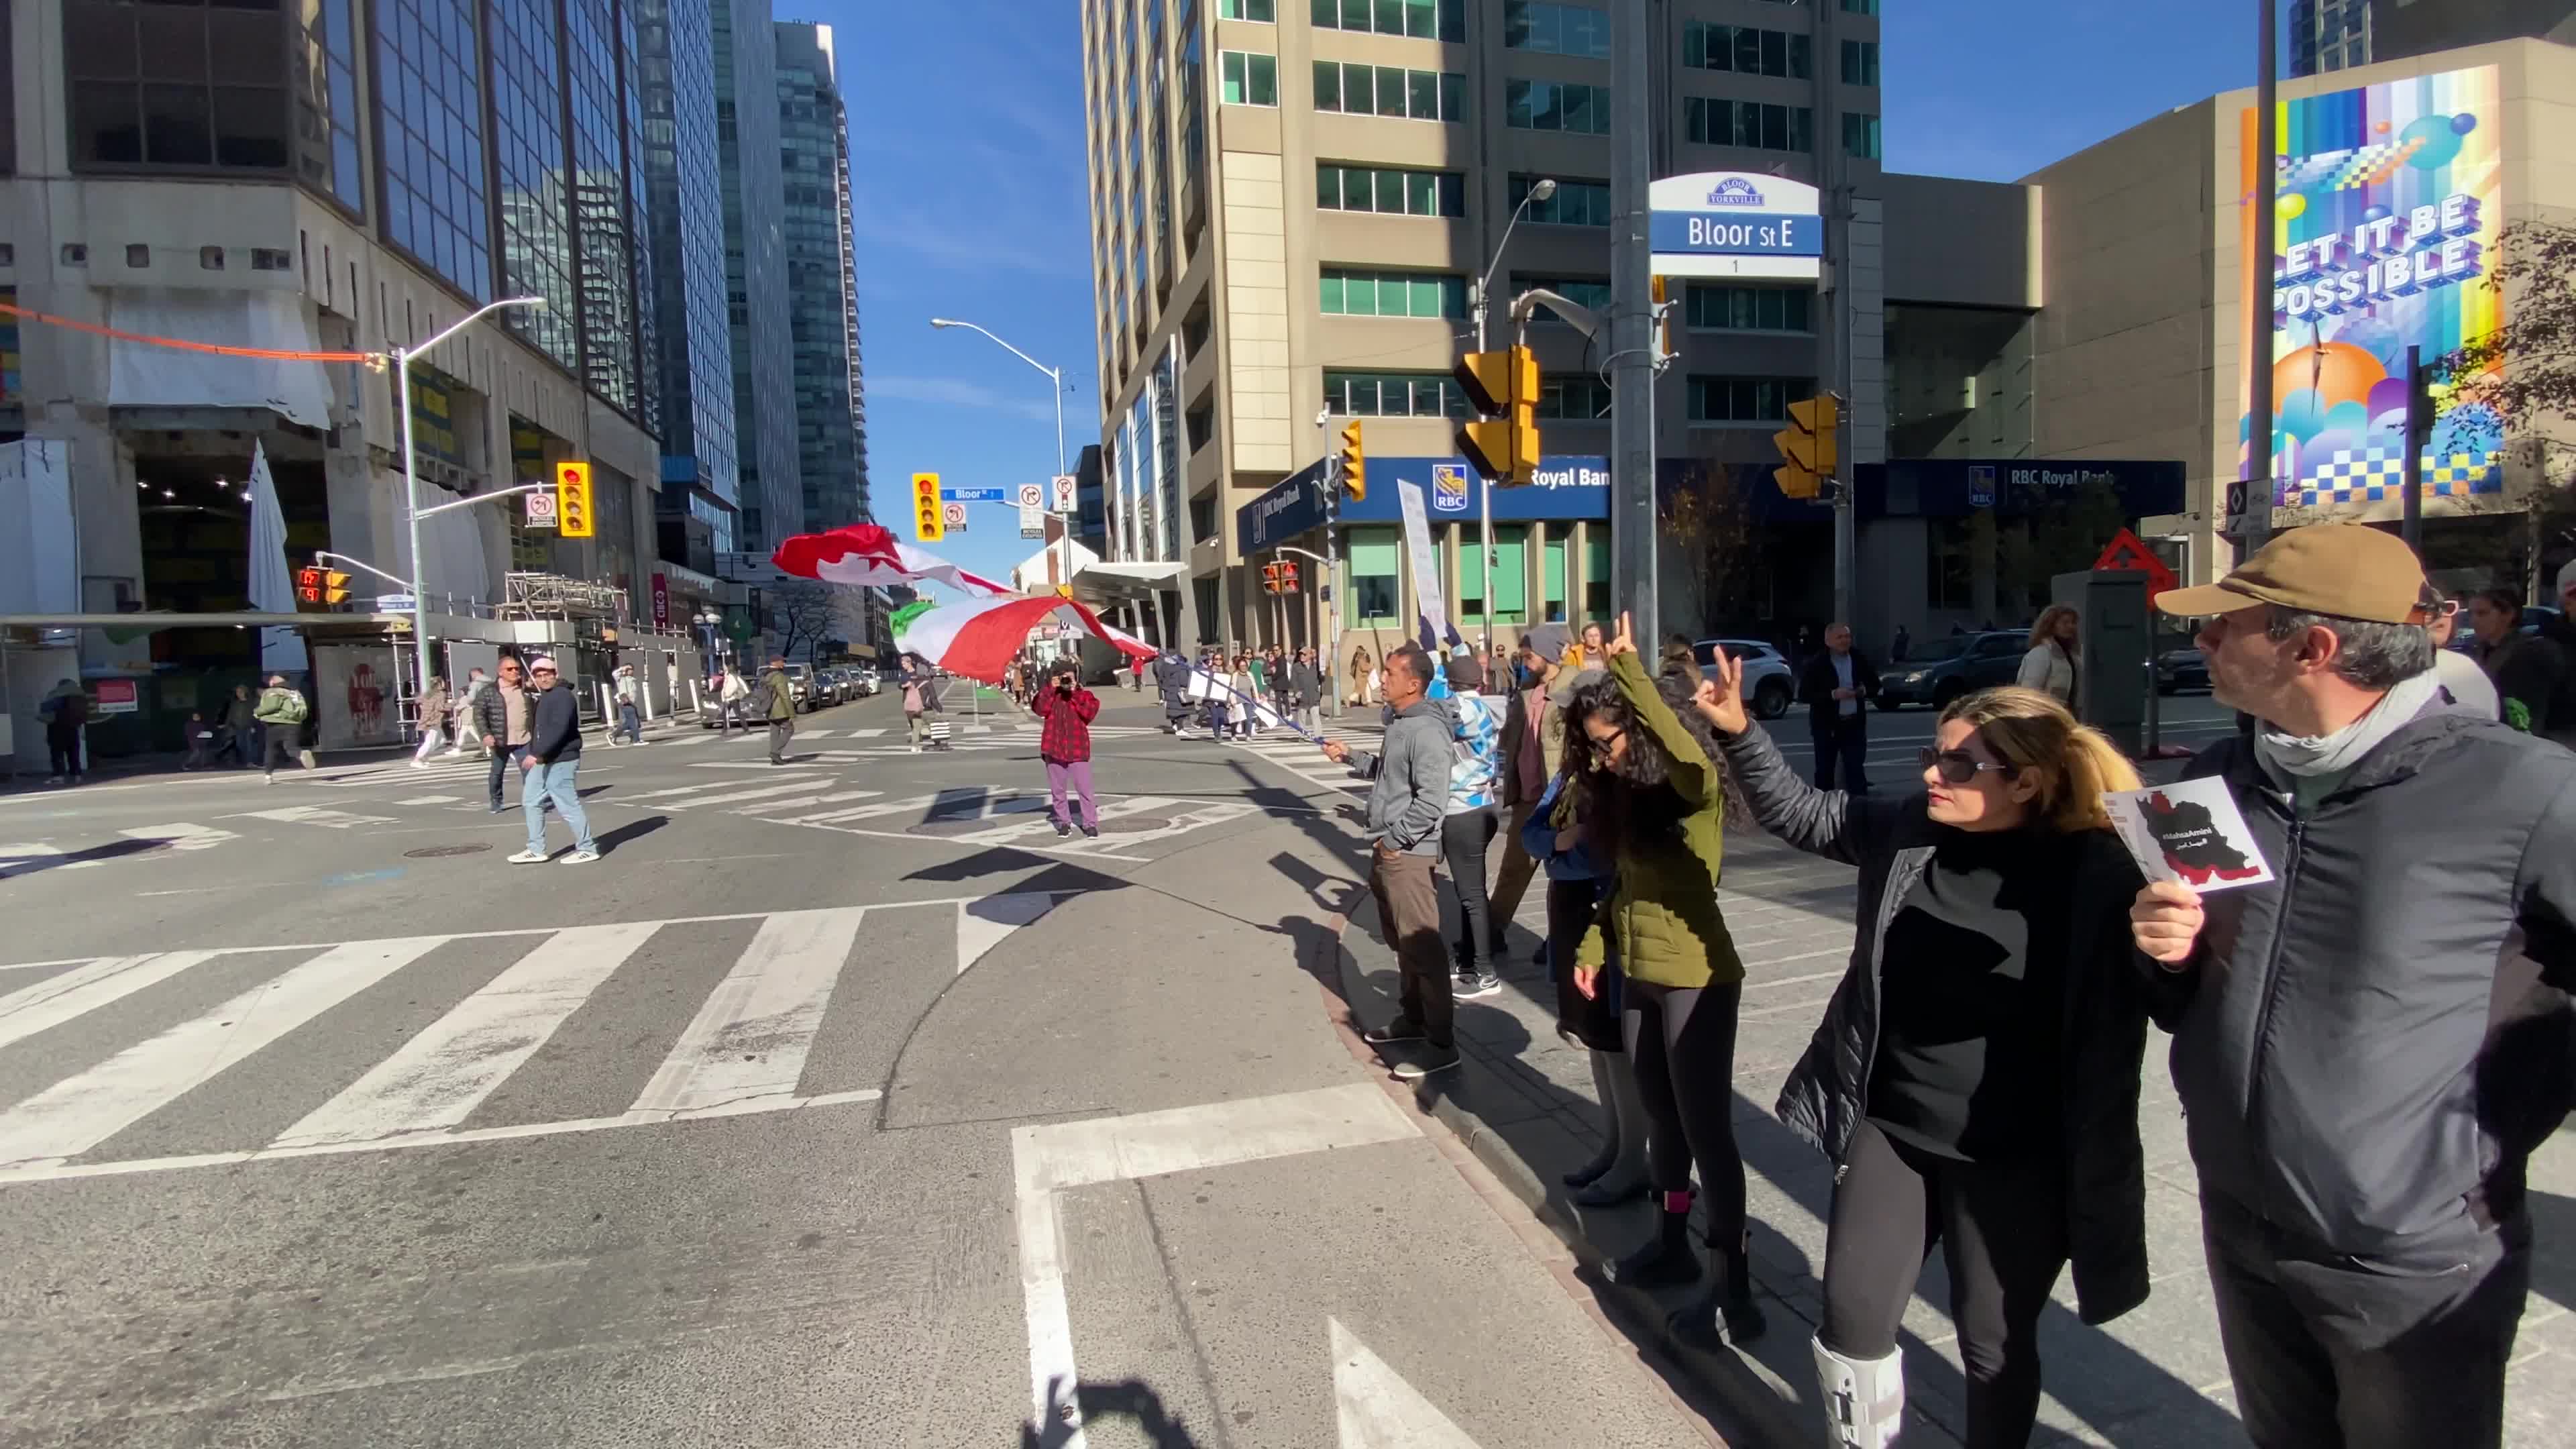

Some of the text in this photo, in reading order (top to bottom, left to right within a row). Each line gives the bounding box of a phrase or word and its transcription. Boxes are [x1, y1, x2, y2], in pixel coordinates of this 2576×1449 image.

[1721, 179, 1750, 192] BLOOR
[1711, 195, 1761, 204] YORKVILLE
[1688, 217, 1793, 247] Bloor St E
[2274, 194, 2467, 280] ET IT BE
[1733, 259, 1738, 273] 1
[1531, 468, 1610, 490] Royal Ban
[2011, 470, 2039, 484] RBC
[2041, 469, 2078, 488] Royal
[955, 489, 981, 499] Bloor
[1438, 496, 1464, 507] RBC
